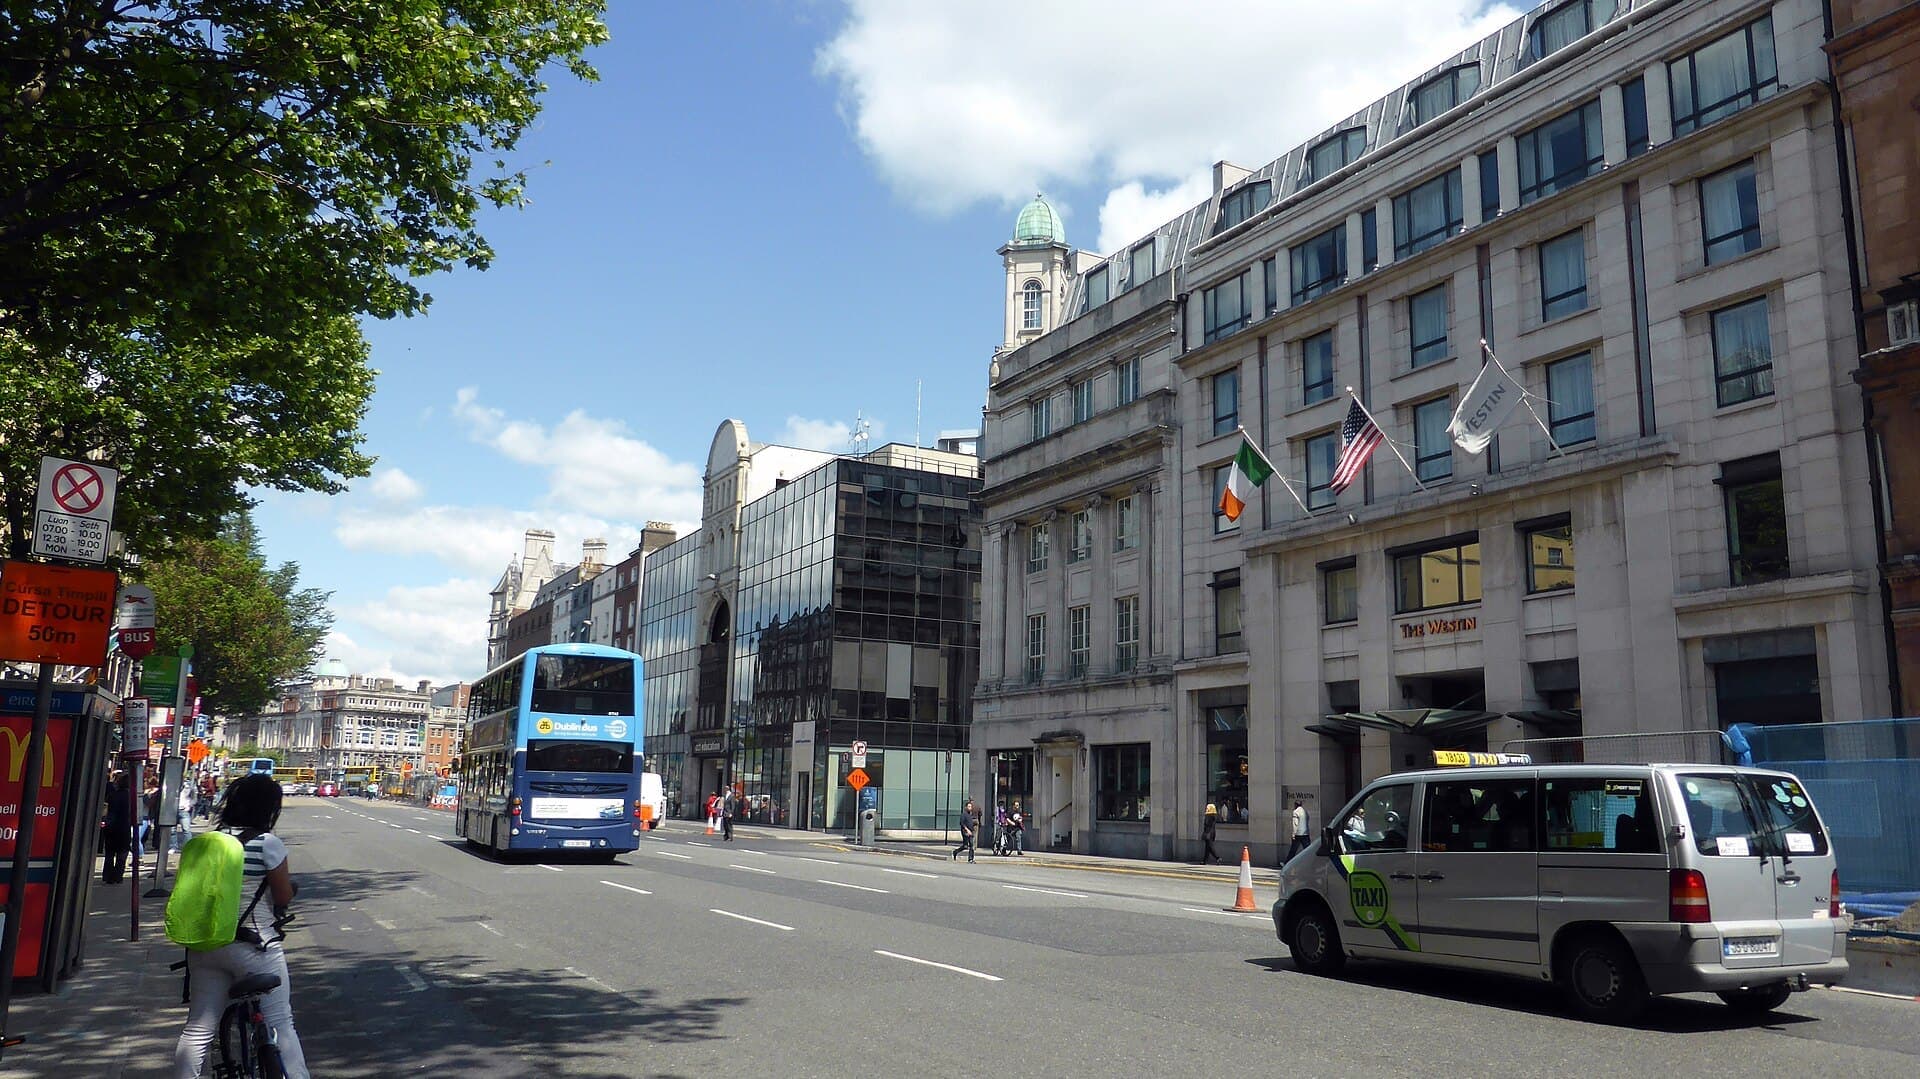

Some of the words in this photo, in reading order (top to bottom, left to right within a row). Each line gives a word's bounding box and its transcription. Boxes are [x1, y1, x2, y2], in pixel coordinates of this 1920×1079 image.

[45, 543, 68, 555] MON
[78, 548, 95, 557] SAT
[3, 598, 105, 623] DETOUR
[28, 624, 76, 644] 50m
[124, 631, 151, 643] BUS
[554, 721, 581, 732] Dublin
[581, 722, 598, 732] Bus
[1472, 752, 1498, 765] TAXI
[1352, 887, 1384, 907] TAXI
